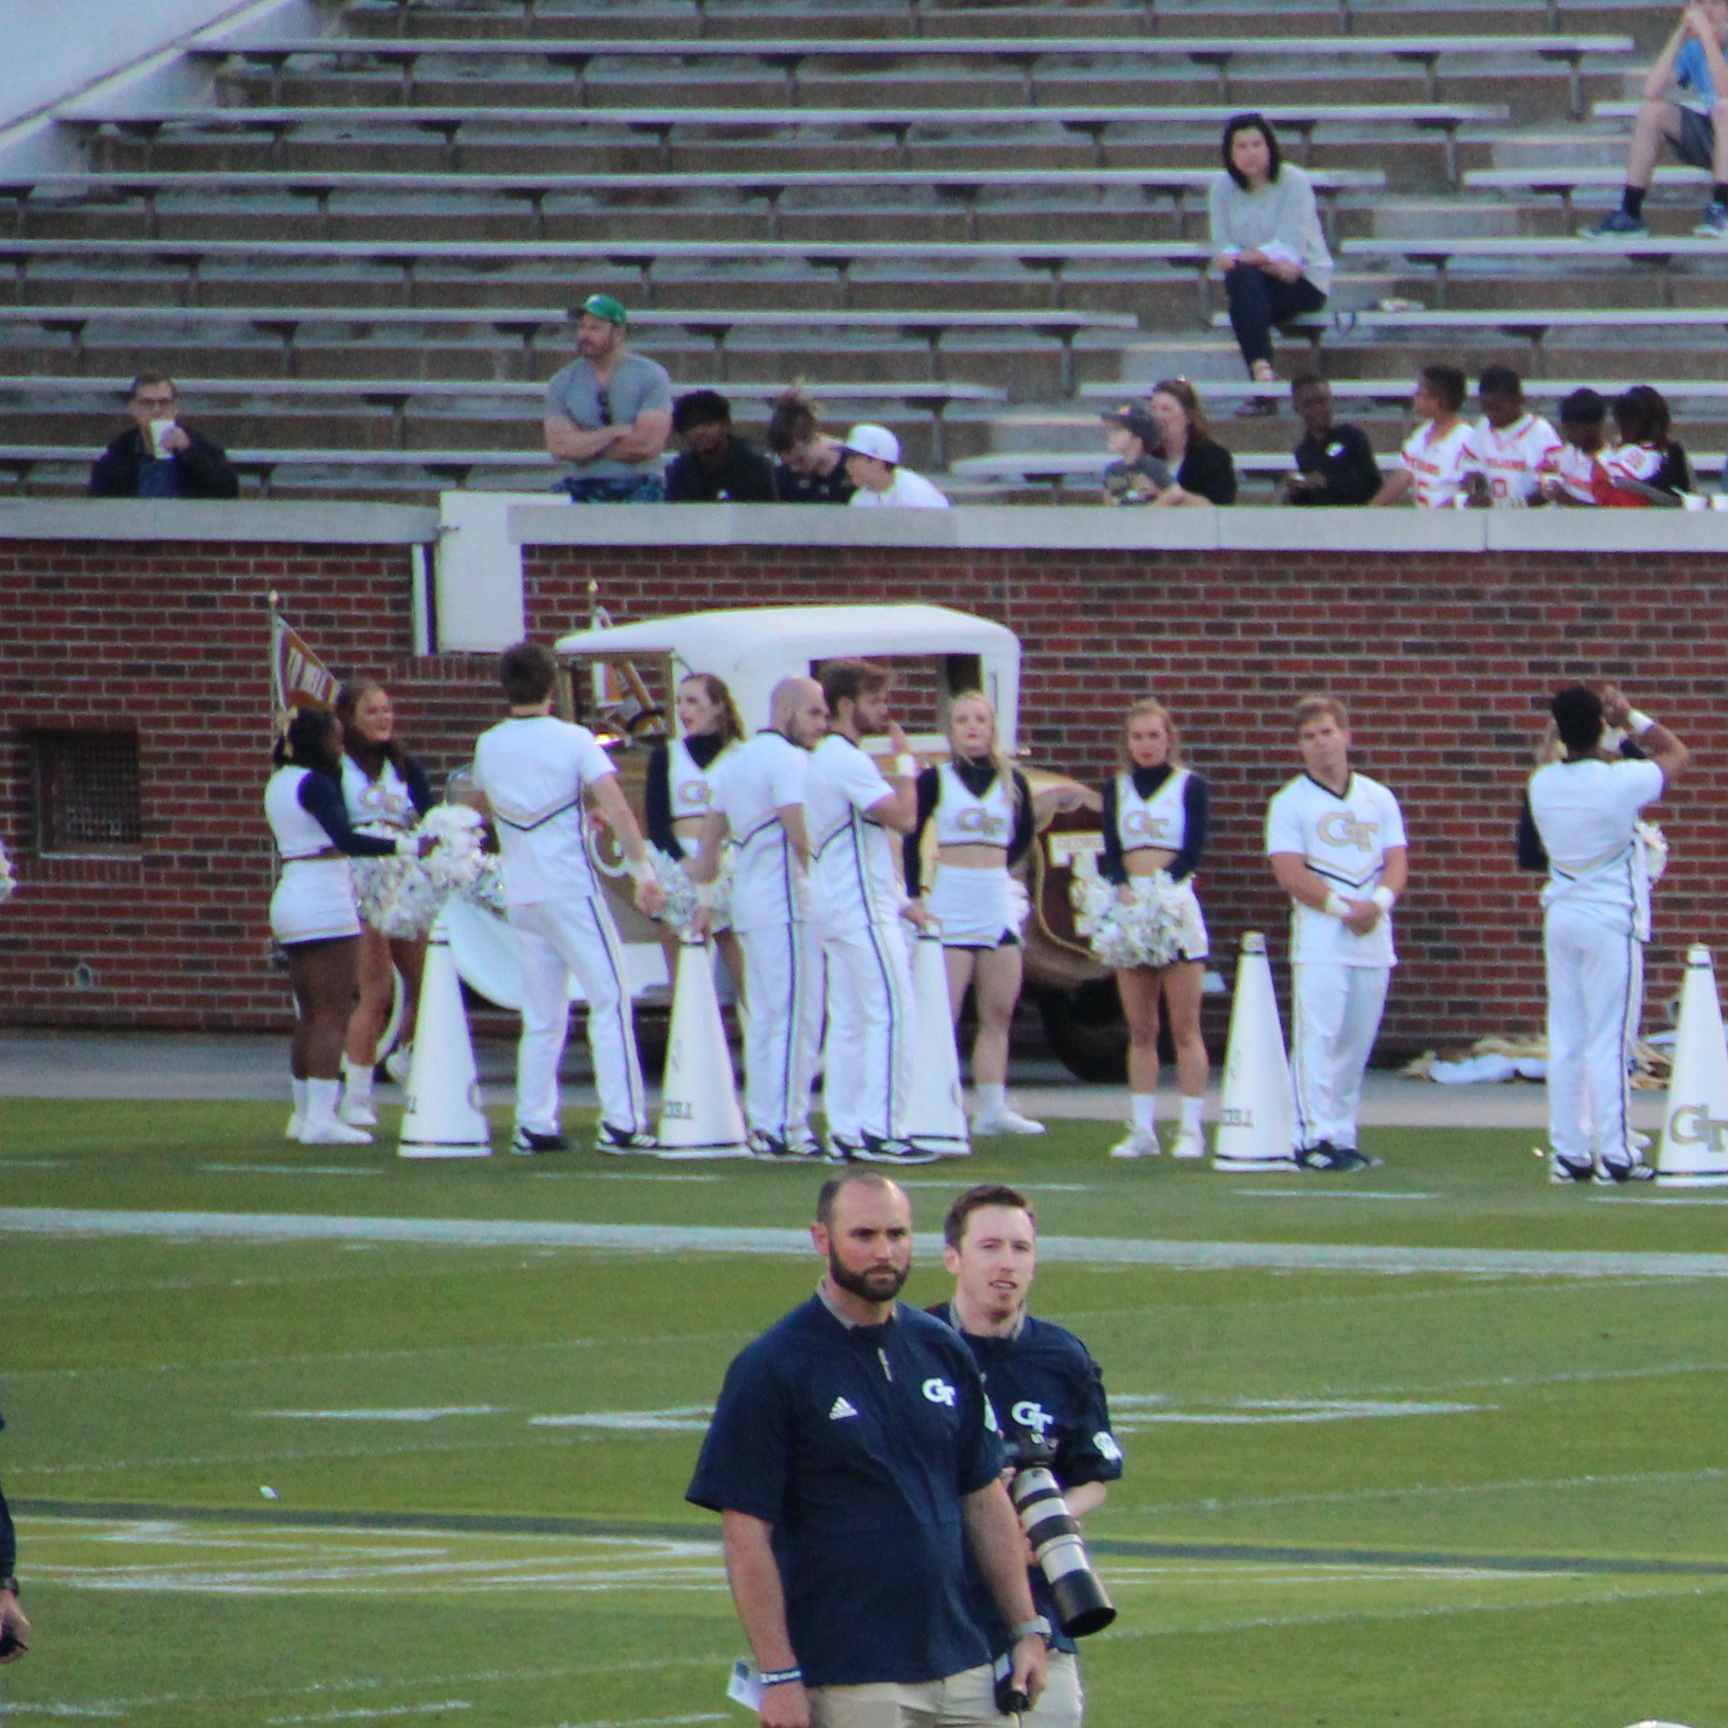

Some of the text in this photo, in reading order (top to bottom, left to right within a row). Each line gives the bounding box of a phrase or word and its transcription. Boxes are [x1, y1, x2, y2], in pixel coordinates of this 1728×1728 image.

[1317, 811, 1380, 853] GT
[922, 1378, 956, 1406] GT
[1011, 1400, 1055, 1433] GT
